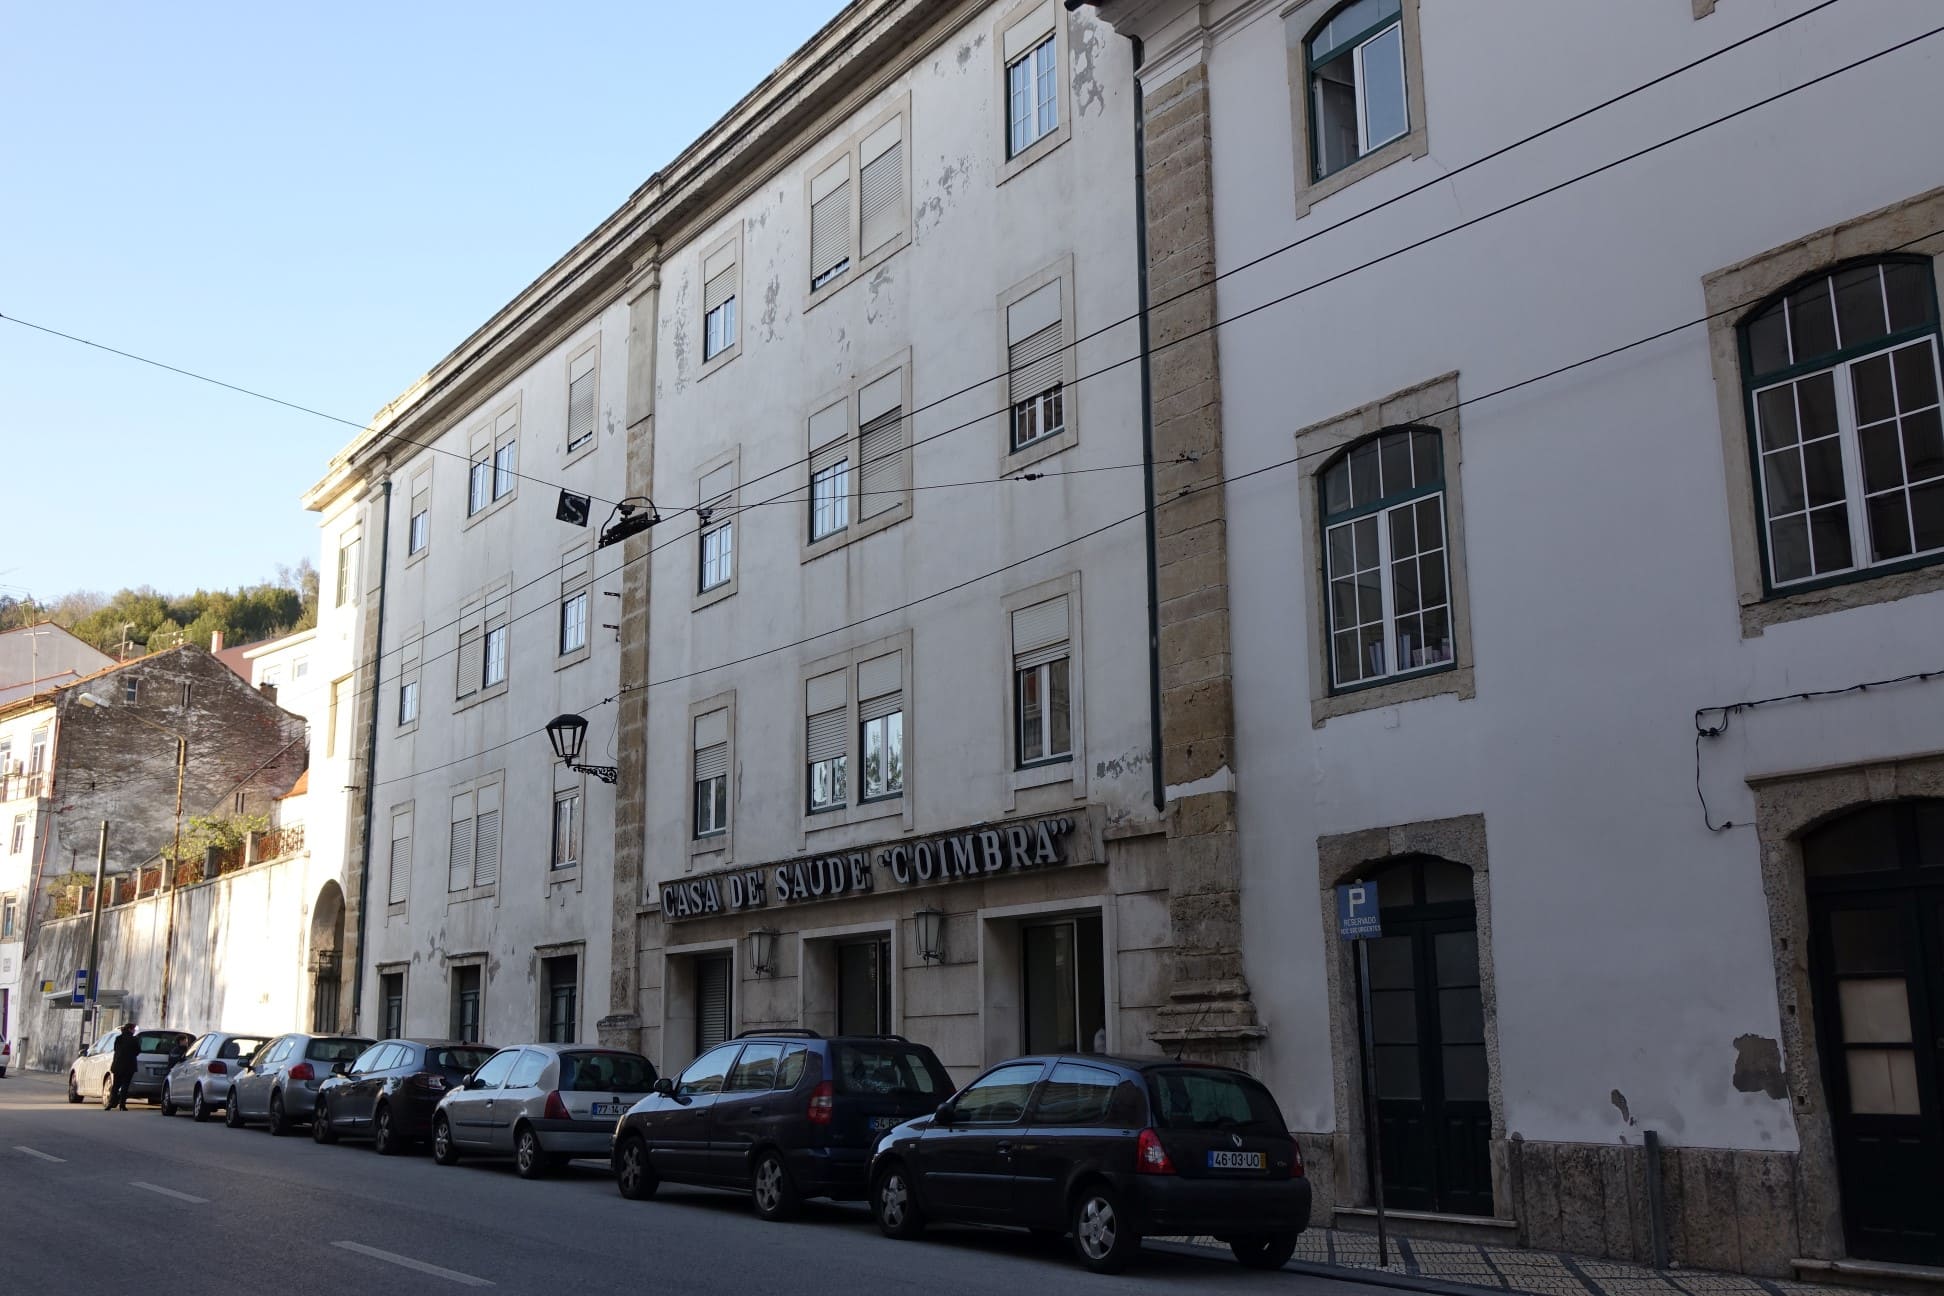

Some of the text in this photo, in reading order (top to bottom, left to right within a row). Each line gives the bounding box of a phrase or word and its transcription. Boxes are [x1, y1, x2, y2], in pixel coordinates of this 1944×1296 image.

[663, 879, 720, 917] CASA
[727, 871, 761, 908] DE
[774, 853, 867, 901] SAUDE
[1349, 888, 1365, 917] P
